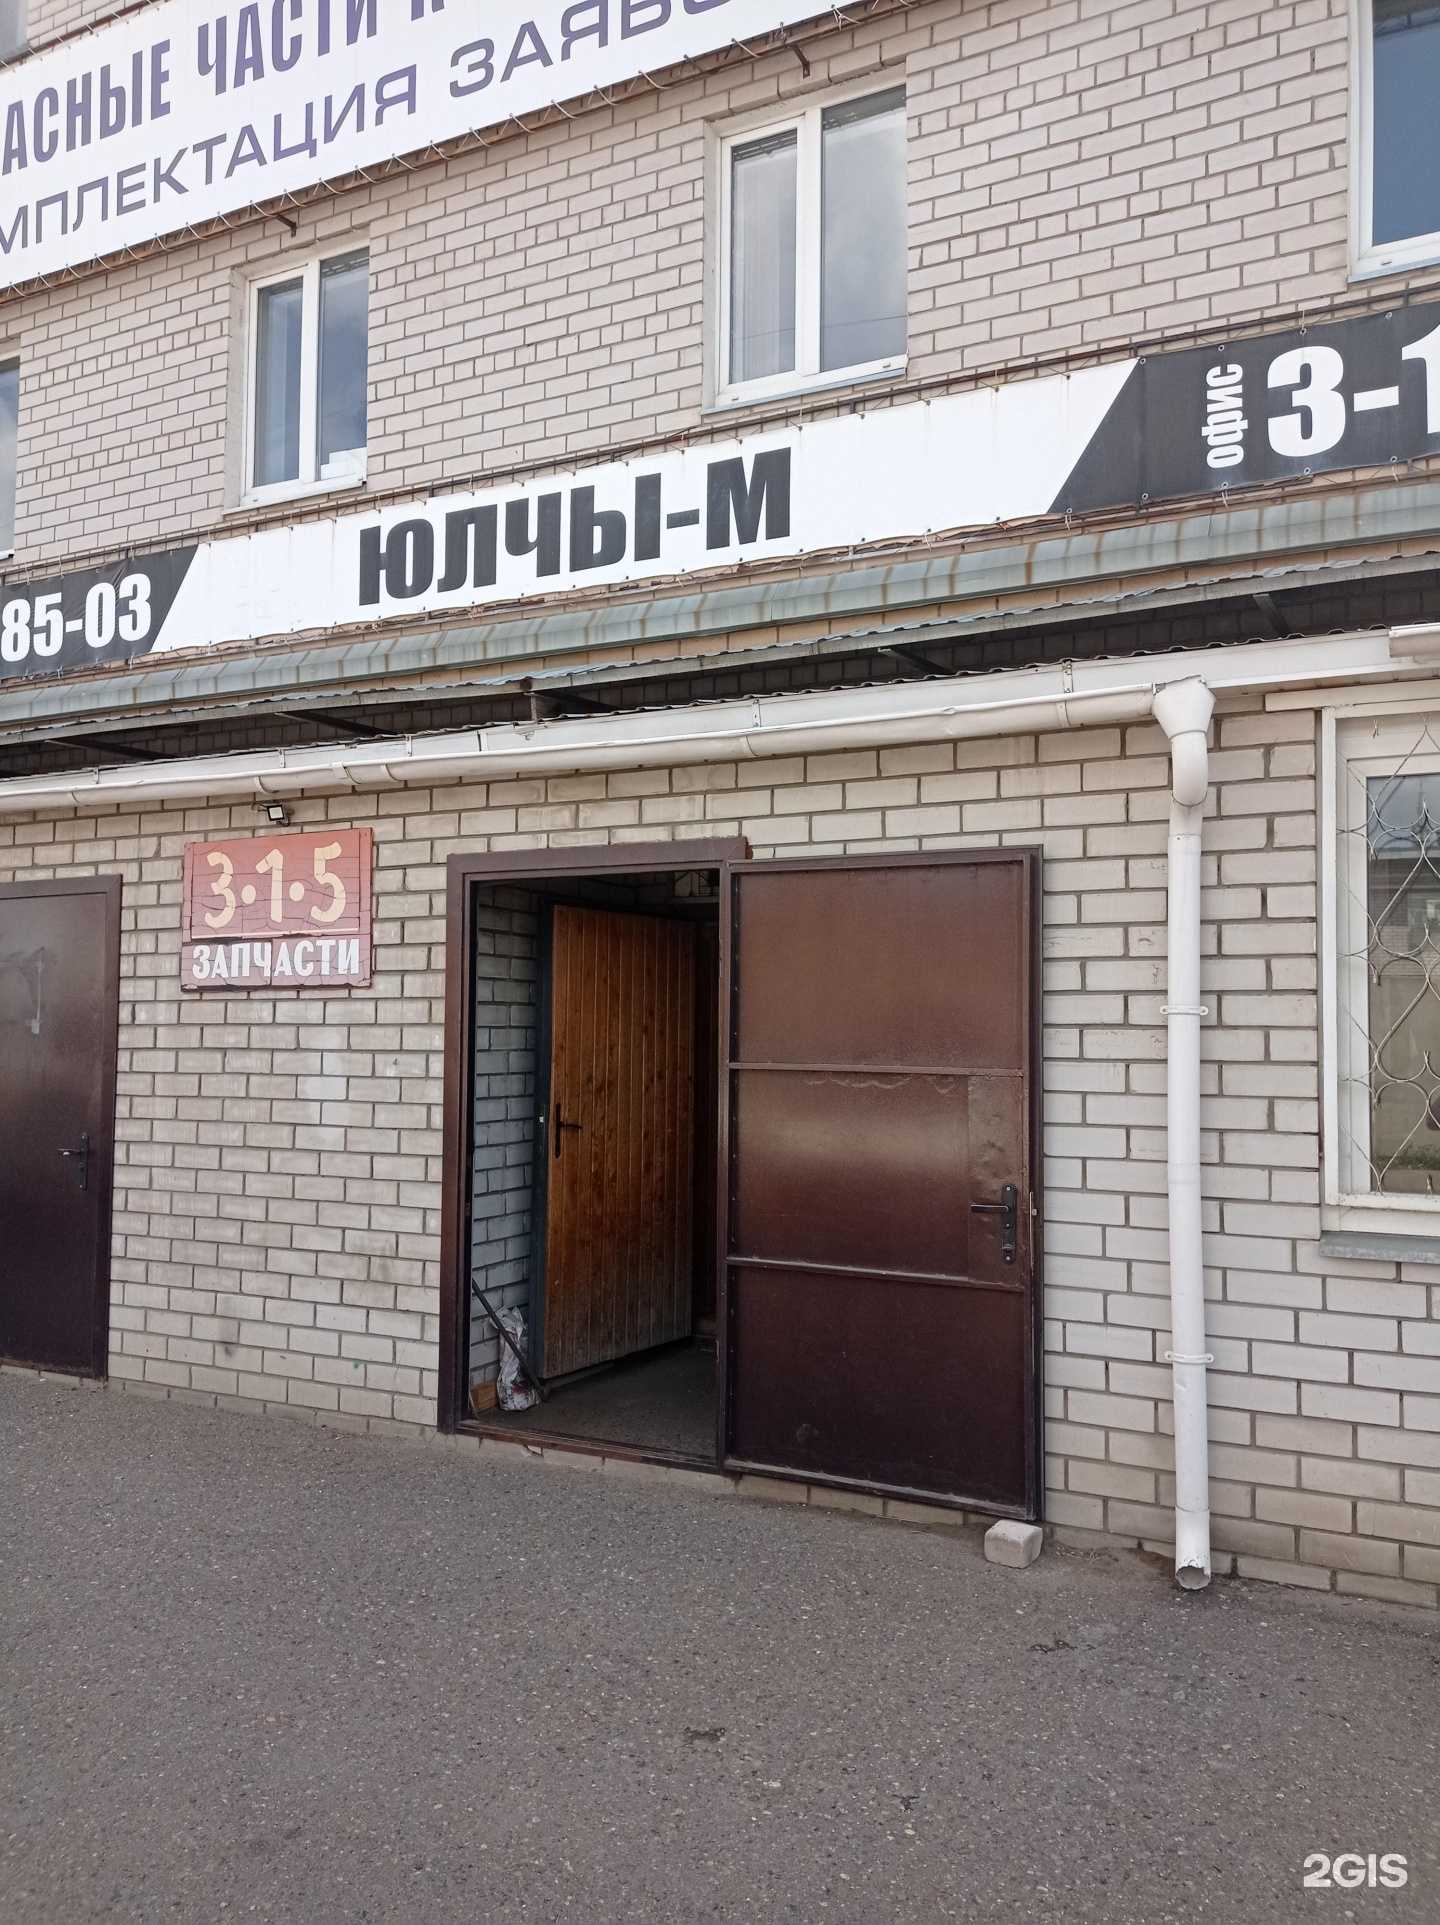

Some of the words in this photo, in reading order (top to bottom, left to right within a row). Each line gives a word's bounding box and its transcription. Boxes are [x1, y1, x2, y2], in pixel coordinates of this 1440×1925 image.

[450, 0, 733, 98] ЗАЯВ
[2, 39, 171, 176] АСНЫЕ
[359, 446, 791, 606] ЮЛЧЫ-М
[1, 573, 151, 663] 85-03
[192, 938, 360, 979] ЗАПЧАСТИ
